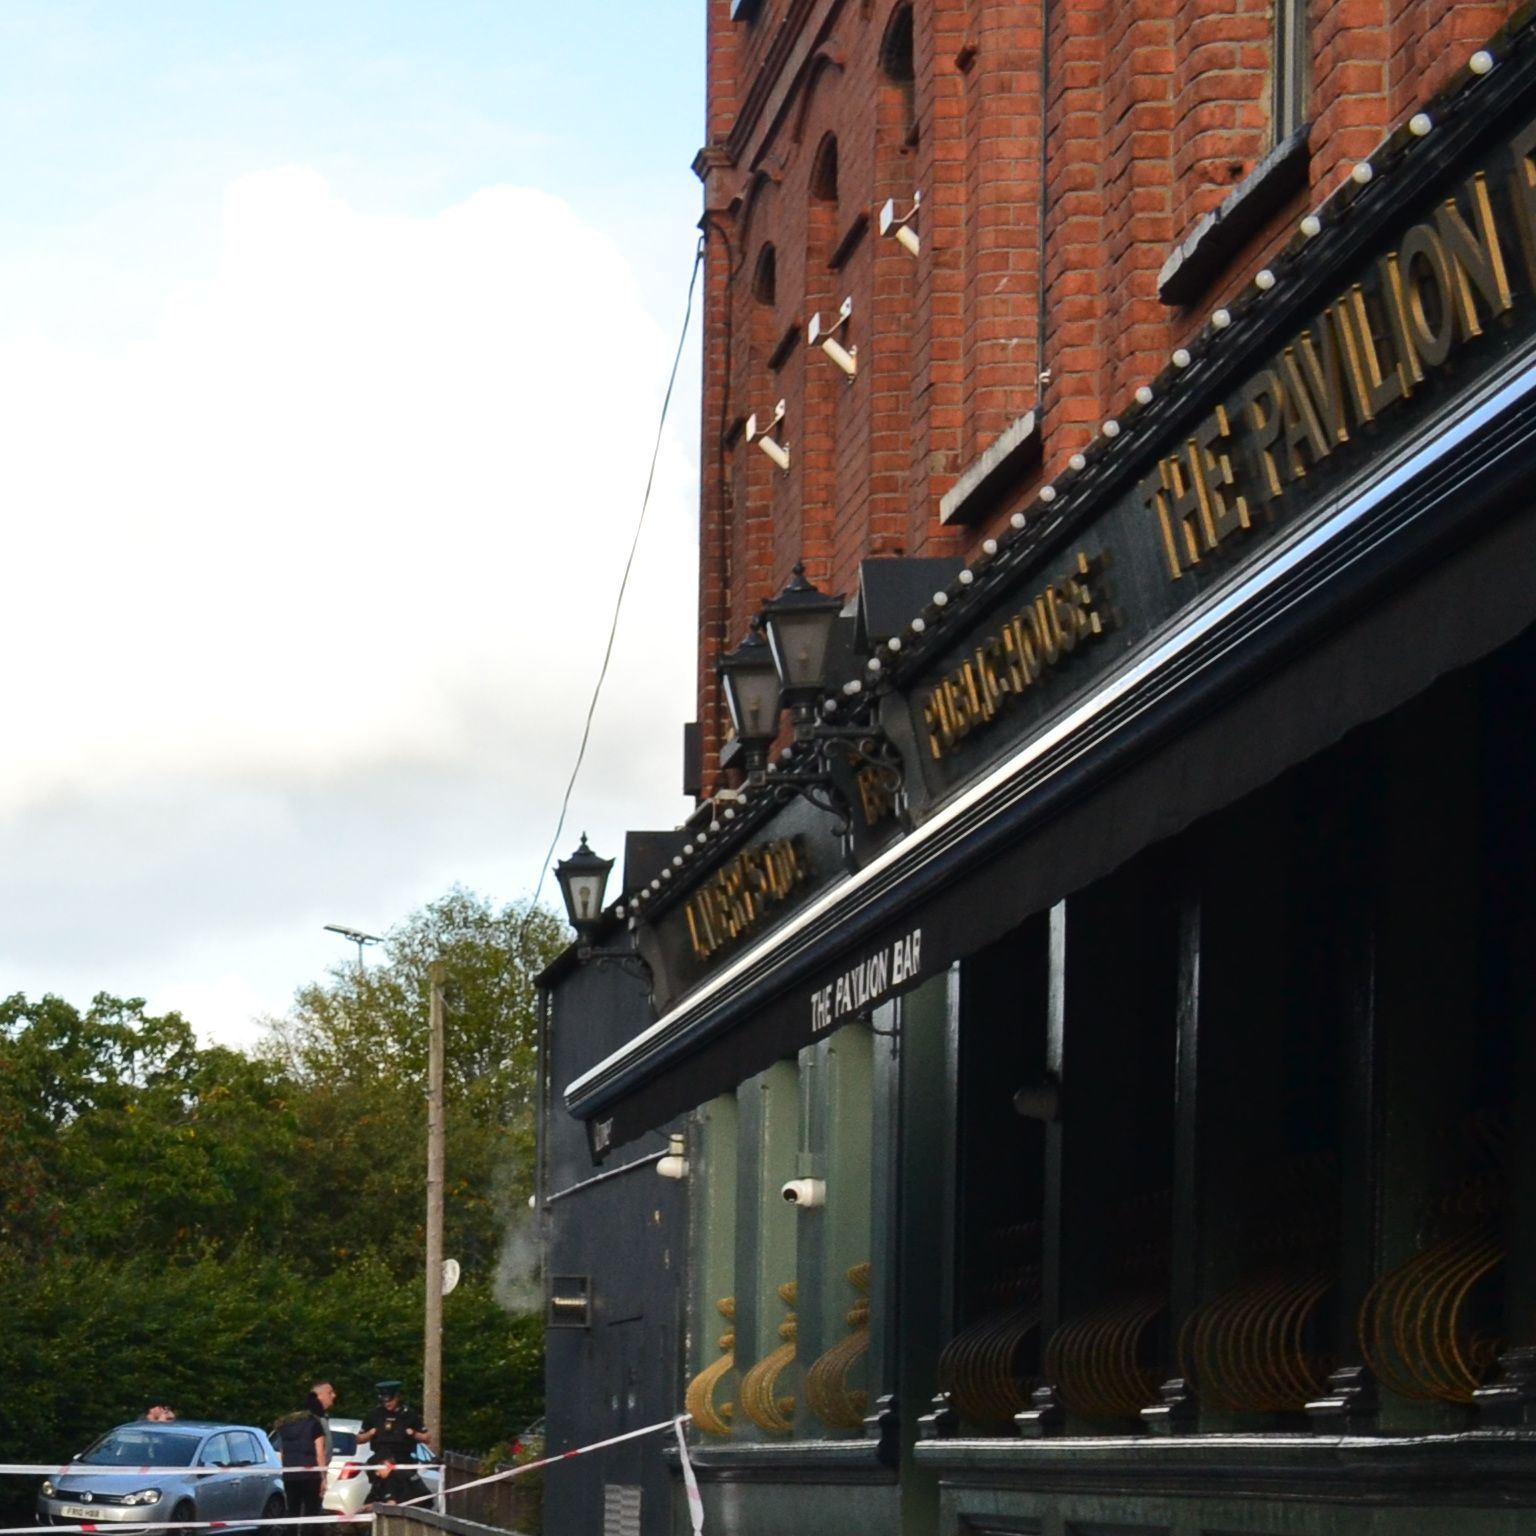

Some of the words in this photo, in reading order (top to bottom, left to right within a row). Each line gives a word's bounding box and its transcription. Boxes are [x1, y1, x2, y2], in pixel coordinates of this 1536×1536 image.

[1140, 405, 1251, 581] THE
[1246, 169, 1514, 500] PAVILION
[1001, 552, 1103, 694] HOUSE
[810, 984, 833, 1032] THE
[834, 948, 889, 1018] PAVILION
[892, 928, 921, 985] BAR
